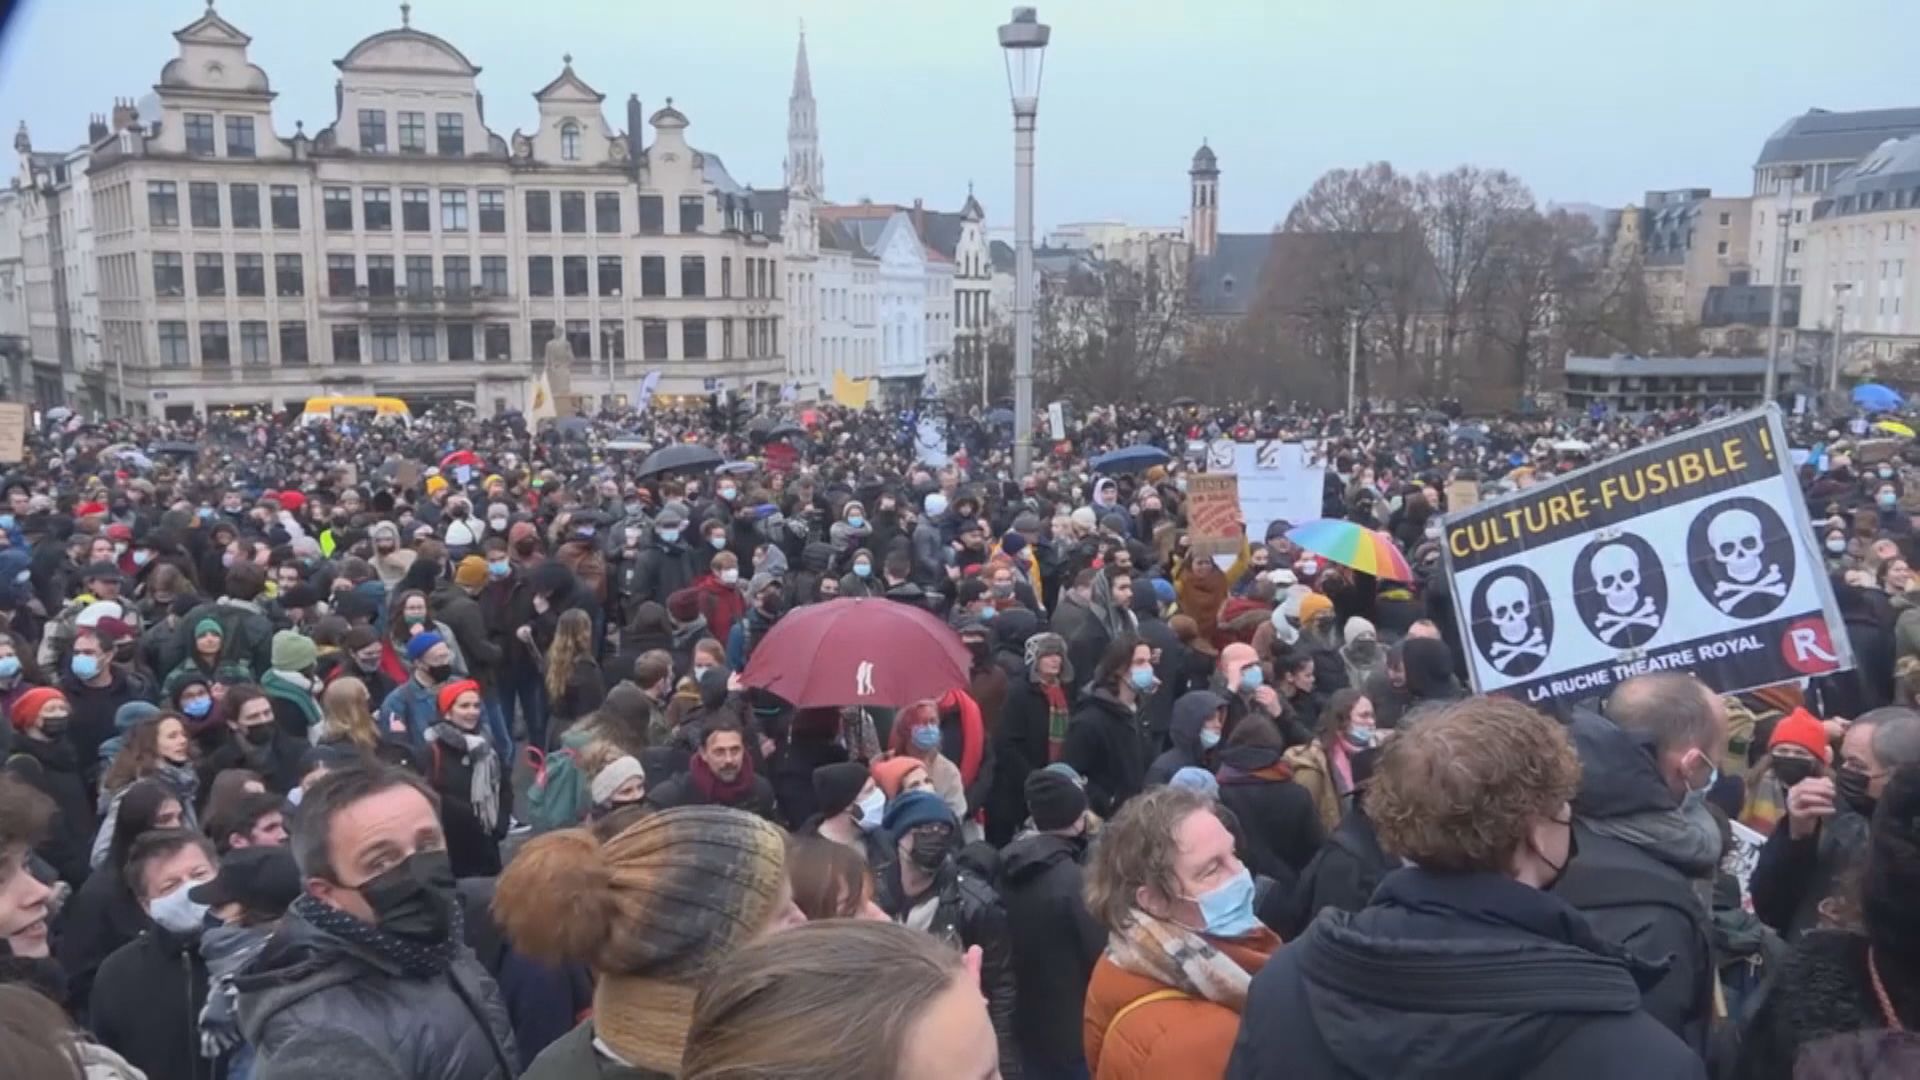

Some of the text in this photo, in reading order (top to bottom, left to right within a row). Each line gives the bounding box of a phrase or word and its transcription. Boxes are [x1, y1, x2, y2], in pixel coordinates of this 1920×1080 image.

[1448, 437, 1748, 558] CULTURE-FUSIBLE
[1527, 635, 1765, 702] LA RUCHE THEATRE ROYAL
[1791, 627, 1840, 664] R
